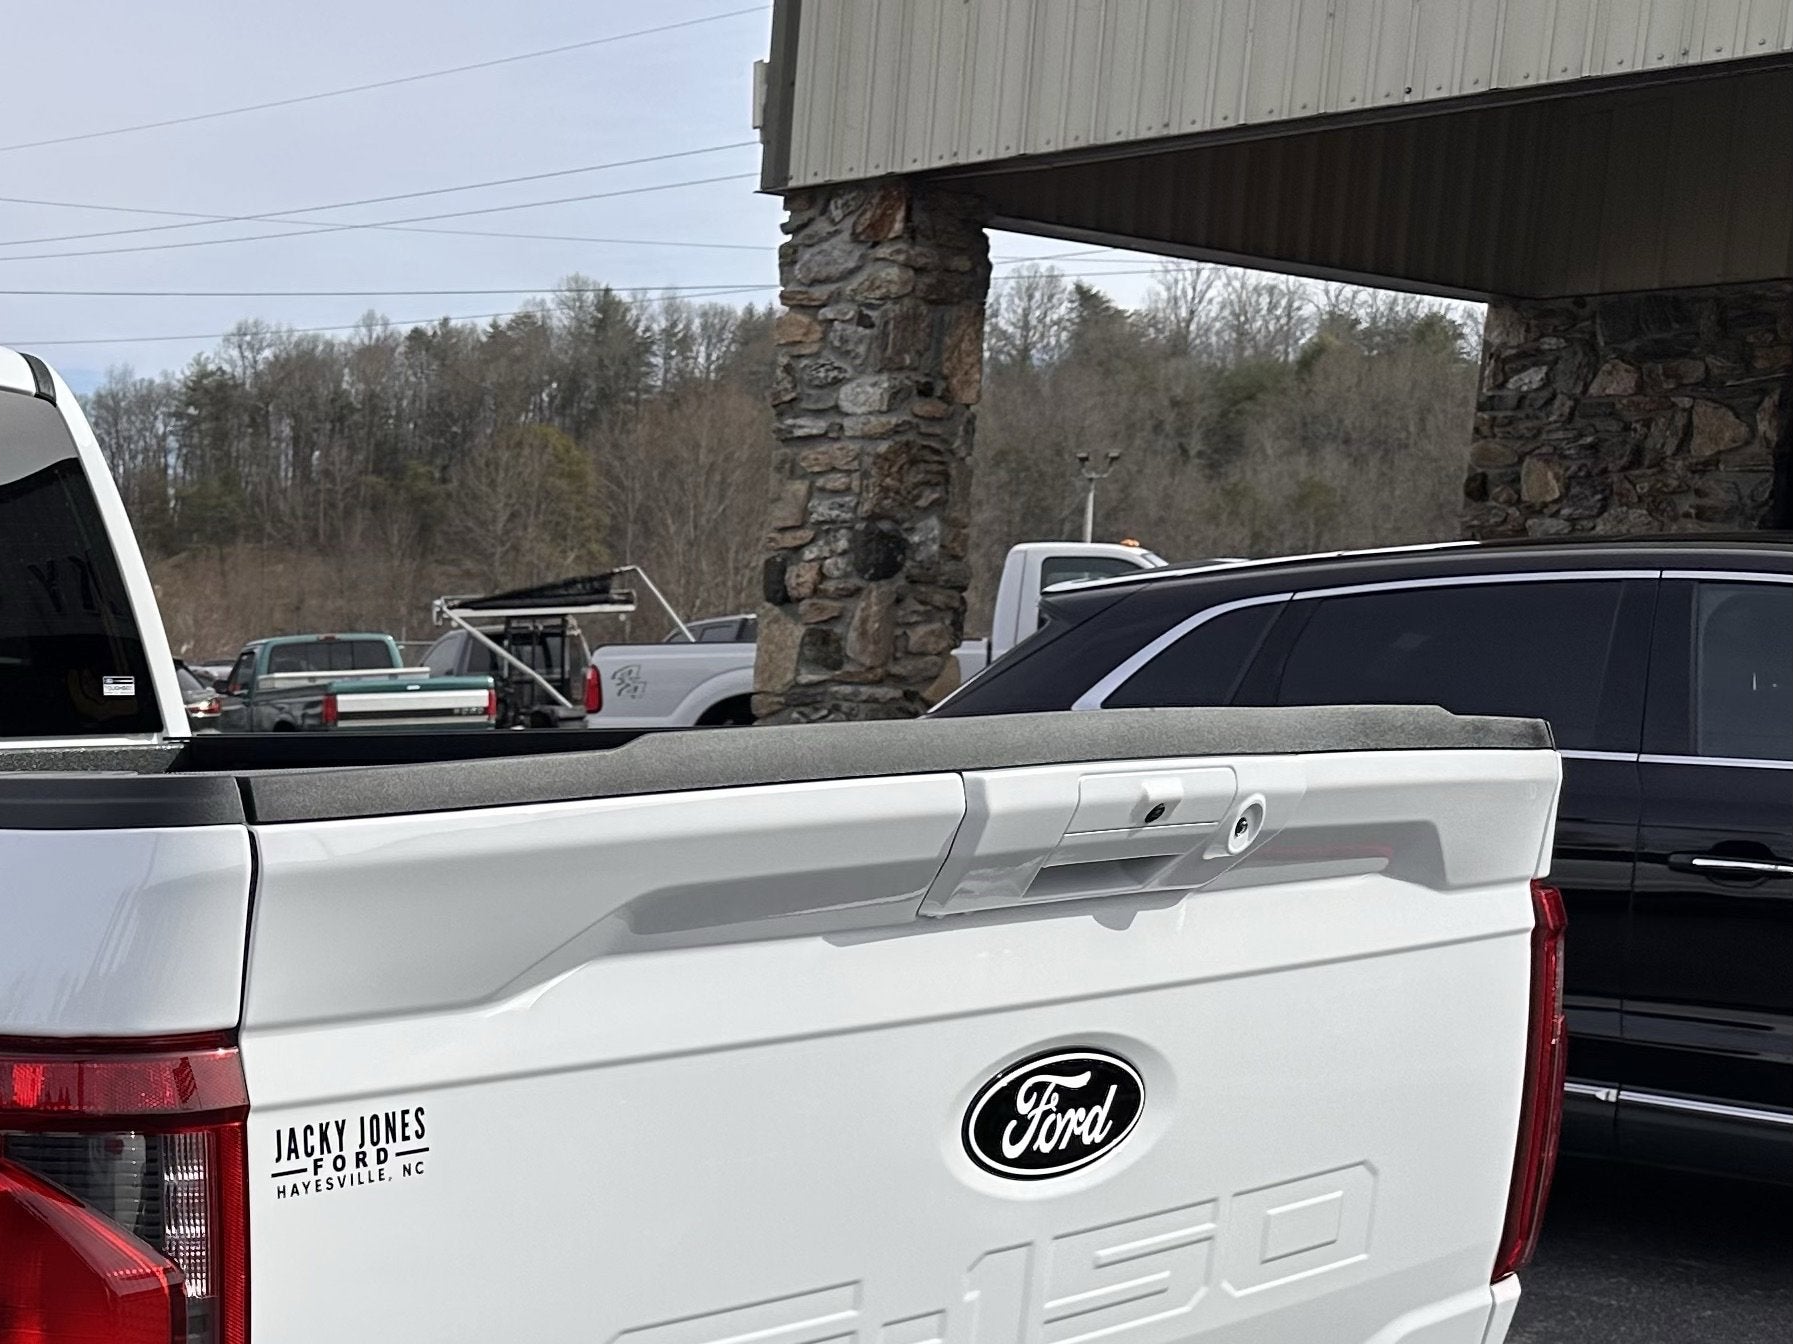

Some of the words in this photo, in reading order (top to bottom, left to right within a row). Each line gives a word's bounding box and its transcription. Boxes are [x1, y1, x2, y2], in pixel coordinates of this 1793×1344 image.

[274, 1118, 347, 1164] JACKY
[357, 1106, 427, 1150] JONES
[1001, 1069, 1117, 1160] Ford
[276, 1167, 393, 1200] HAYESVILLE,
[402, 1161, 425, 1177] NC
[312, 1147, 389, 1176] FORD
